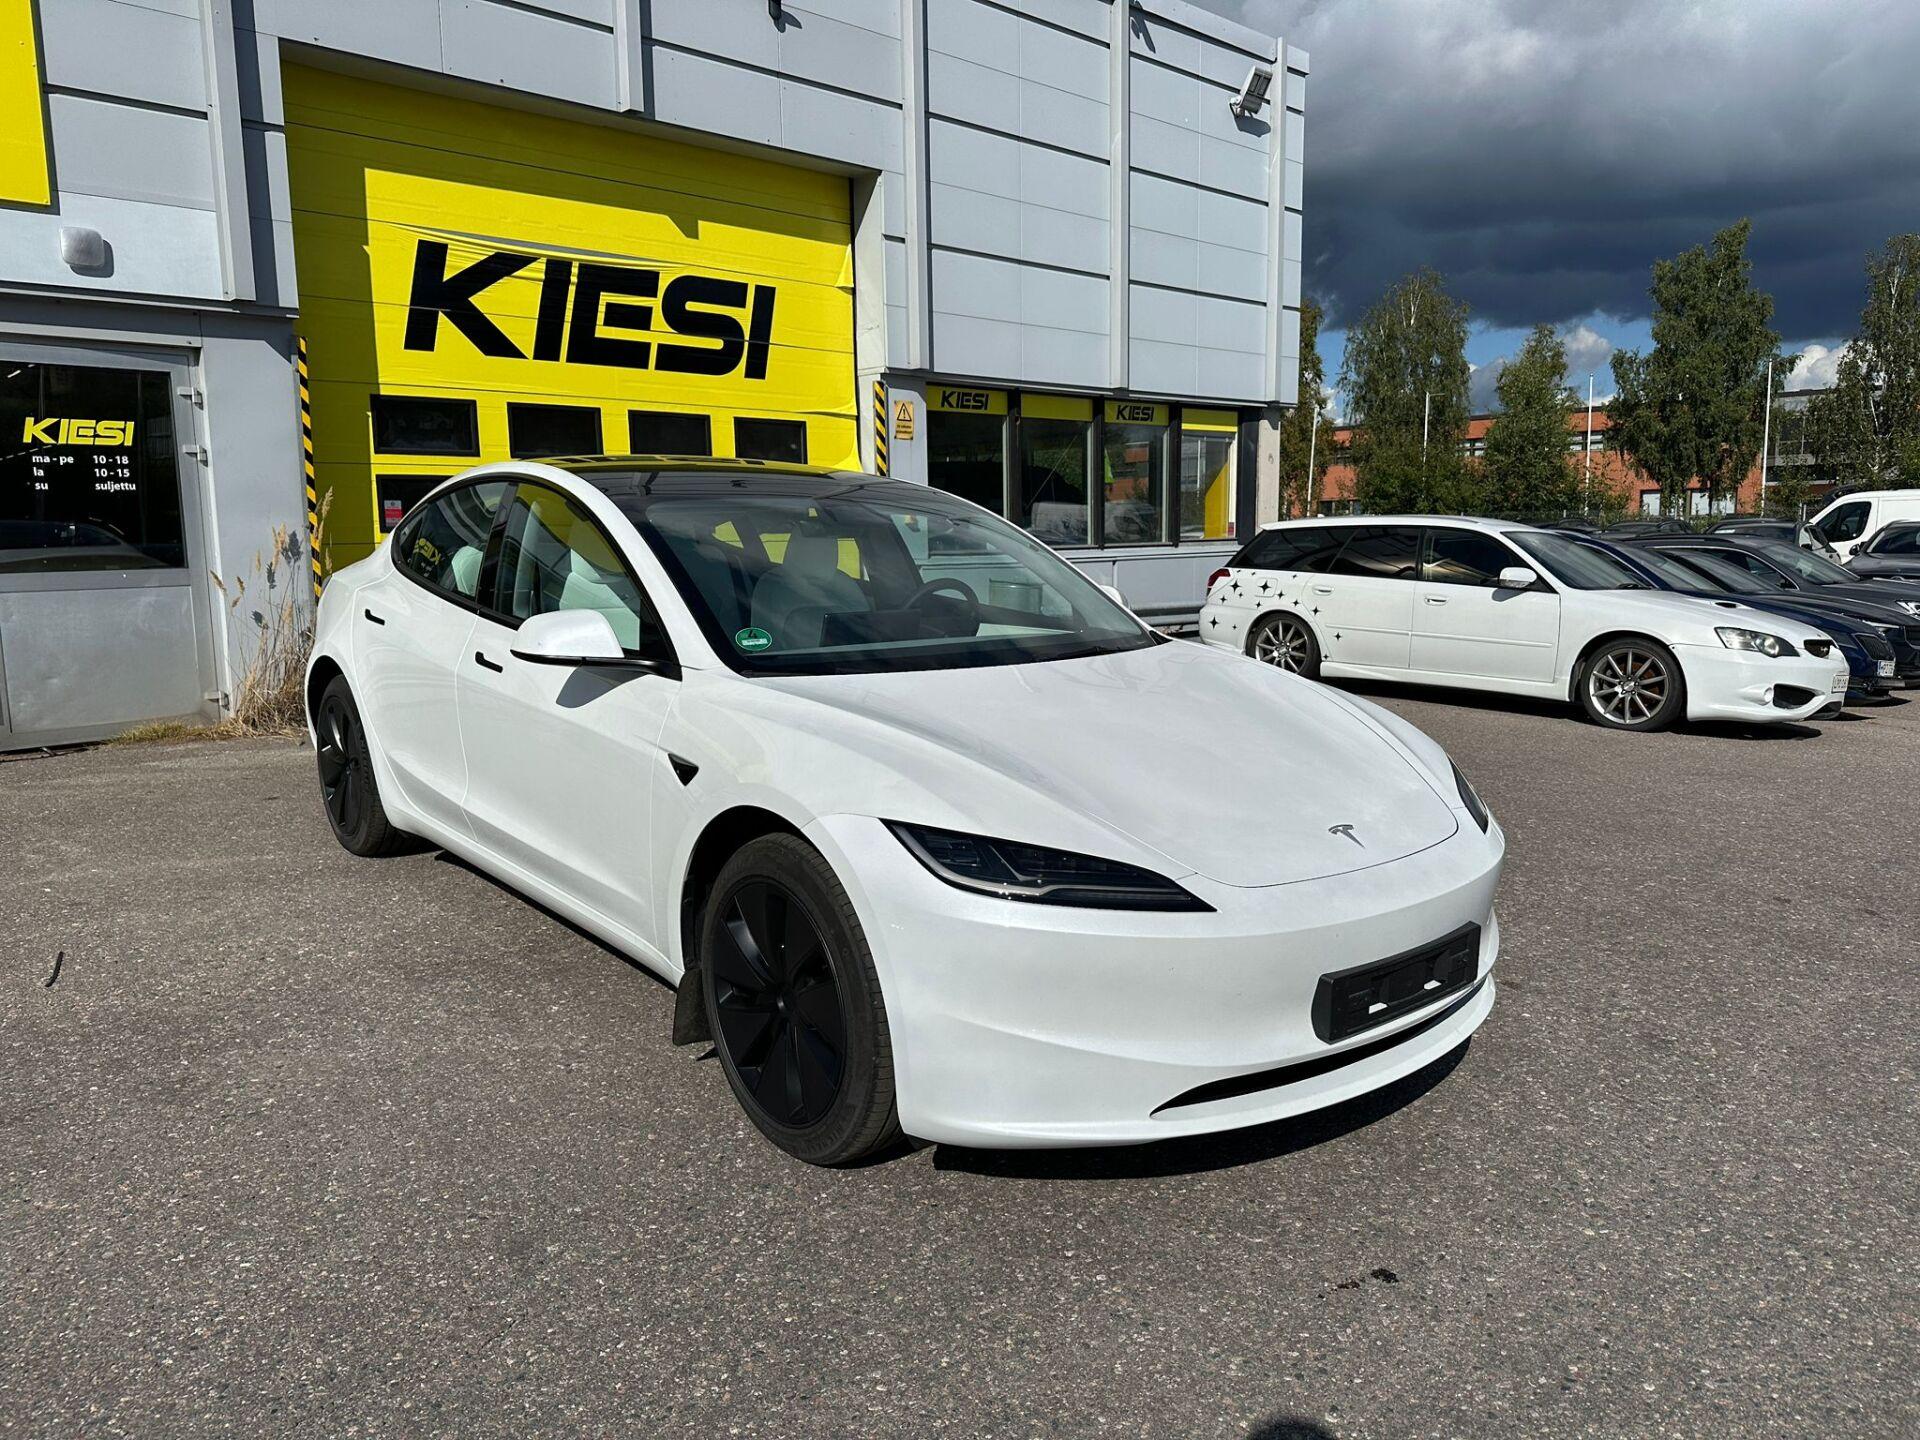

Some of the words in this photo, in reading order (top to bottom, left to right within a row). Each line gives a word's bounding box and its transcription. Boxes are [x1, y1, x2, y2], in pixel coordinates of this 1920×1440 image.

[403, 238, 777, 380] KIESI
[941, 390, 989, 410] KIESI
[1116, 404, 1155, 422] KIESI
[23, 417, 135, 447] KIESI
[32, 455, 50, 464] ma
[59, 456, 74, 465] pe
[93, 455, 107, 464] 10
[115, 455, 129, 465] 18
[33, 466, 44, 476] la
[94, 468, 108, 477] 10
[117, 468, 130, 477] 15
[35, 482, 49, 490] su
[95, 481, 136, 493] suljettu
